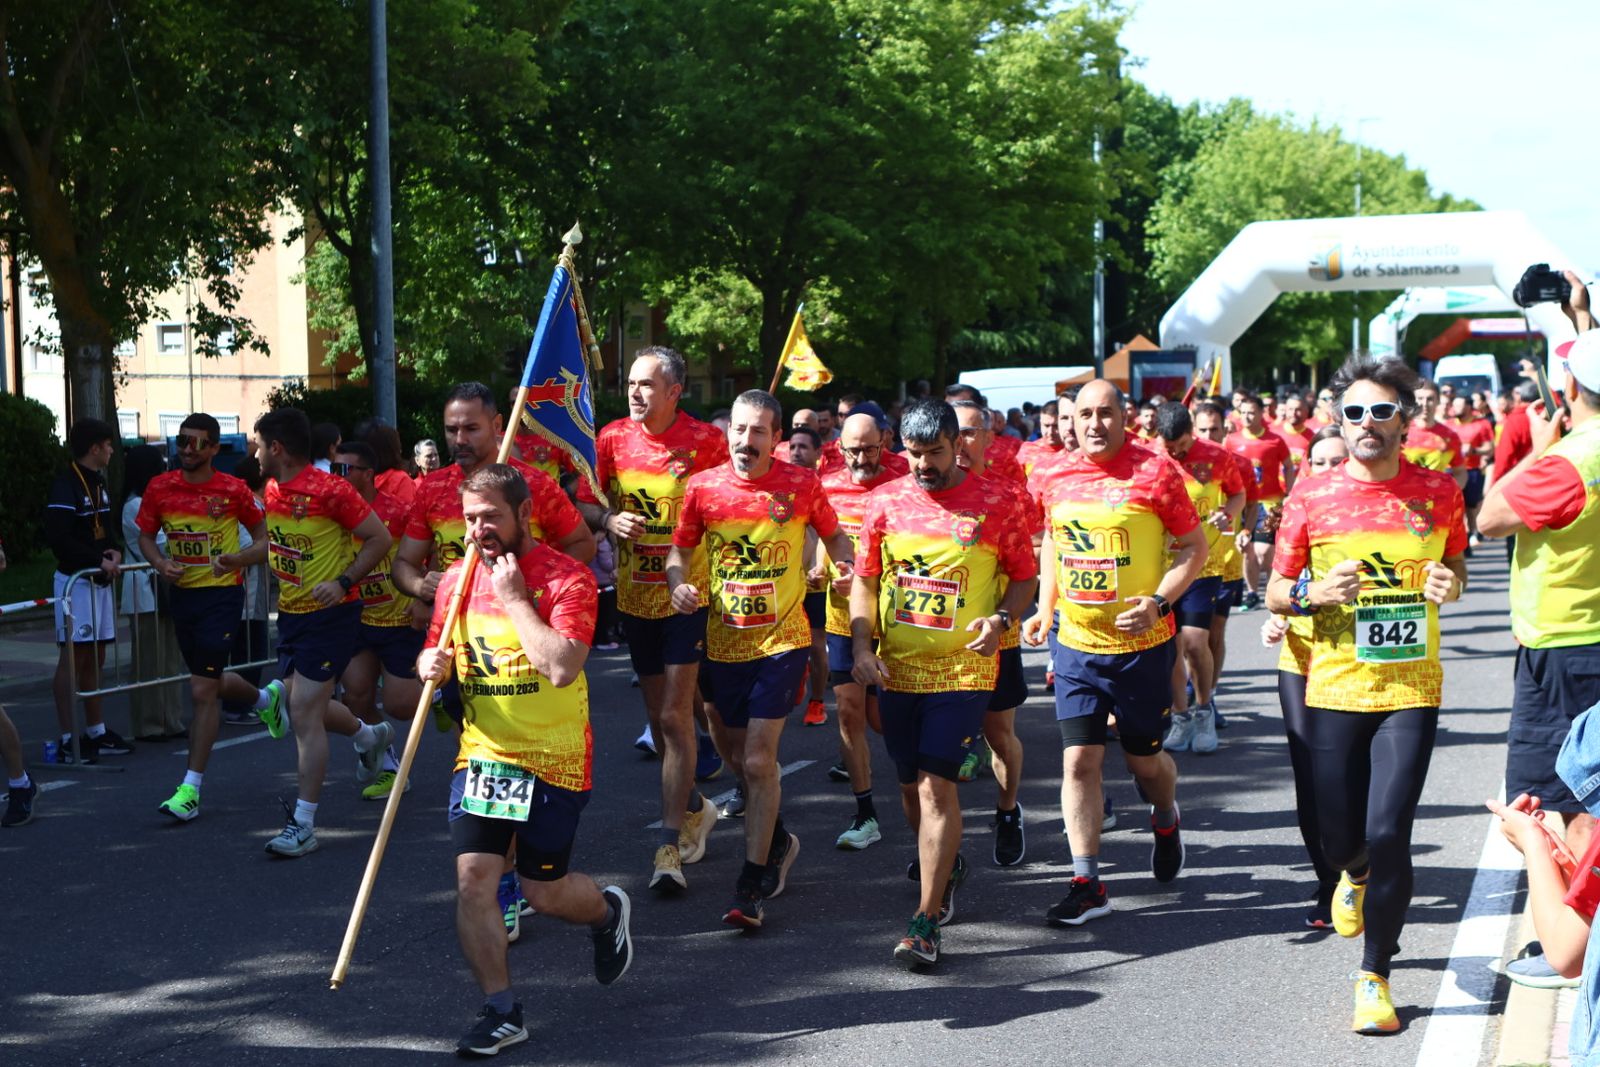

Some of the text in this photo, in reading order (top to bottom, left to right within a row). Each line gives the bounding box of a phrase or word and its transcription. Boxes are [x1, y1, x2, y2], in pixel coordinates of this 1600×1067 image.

[1352, 242, 1460, 260] Ayuntamiento
[1352, 263, 1460, 278] de Salamanca
[176, 541, 203, 556] 160
[274, 555, 297, 574] 159
[639, 556, 666, 572] 28
[1070, 570, 1108, 590] 262
[730, 596, 767, 615] 266
[904, 590, 946, 615] 273
[1373, 594, 1418, 606] FERNANDO
[1368, 621, 1418, 646] 842
[472, 682, 540, 696] FERNANDO 2026
[469, 774, 529, 803] 1534
